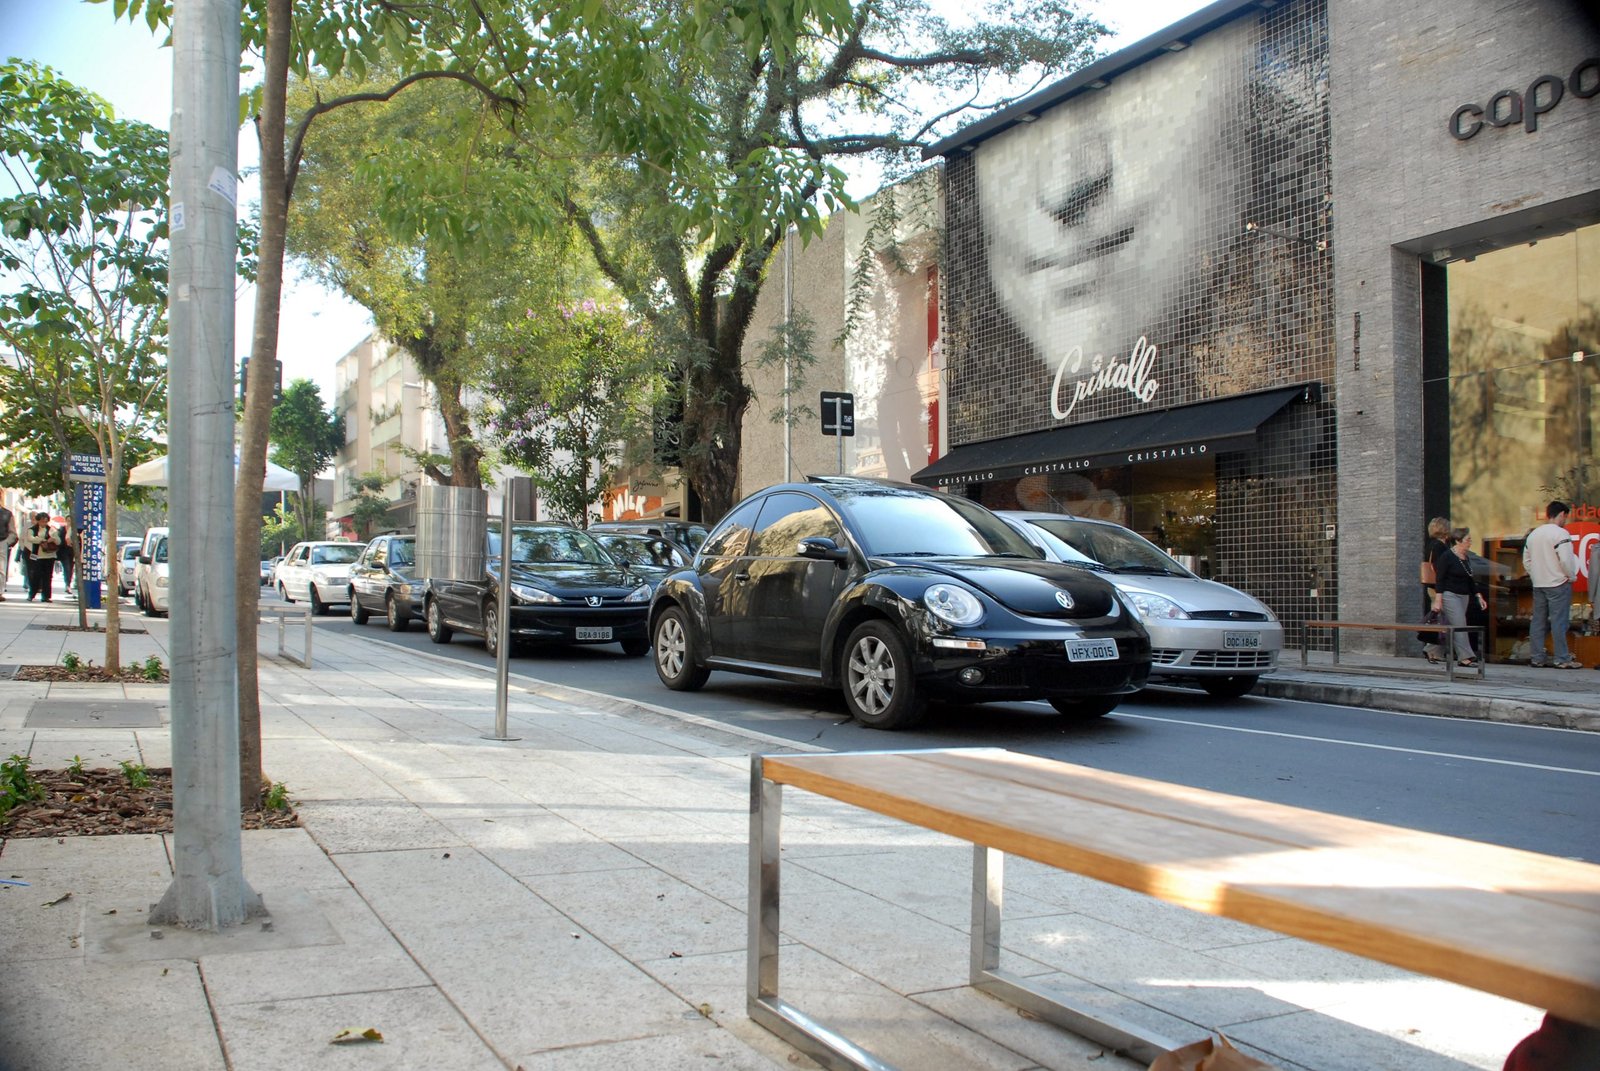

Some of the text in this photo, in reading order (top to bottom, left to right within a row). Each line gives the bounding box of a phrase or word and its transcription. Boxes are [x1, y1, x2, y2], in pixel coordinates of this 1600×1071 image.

[1051, 336, 1160, 420] Cristallo
[1128, 445, 1206, 462] CRISTALLO
[1024, 460, 1090, 475] CRISTALLO
[938, 472, 994, 486] CRISTALLO
[612, 488, 647, 521] MILK
[92, 515, 98, 527] DE
